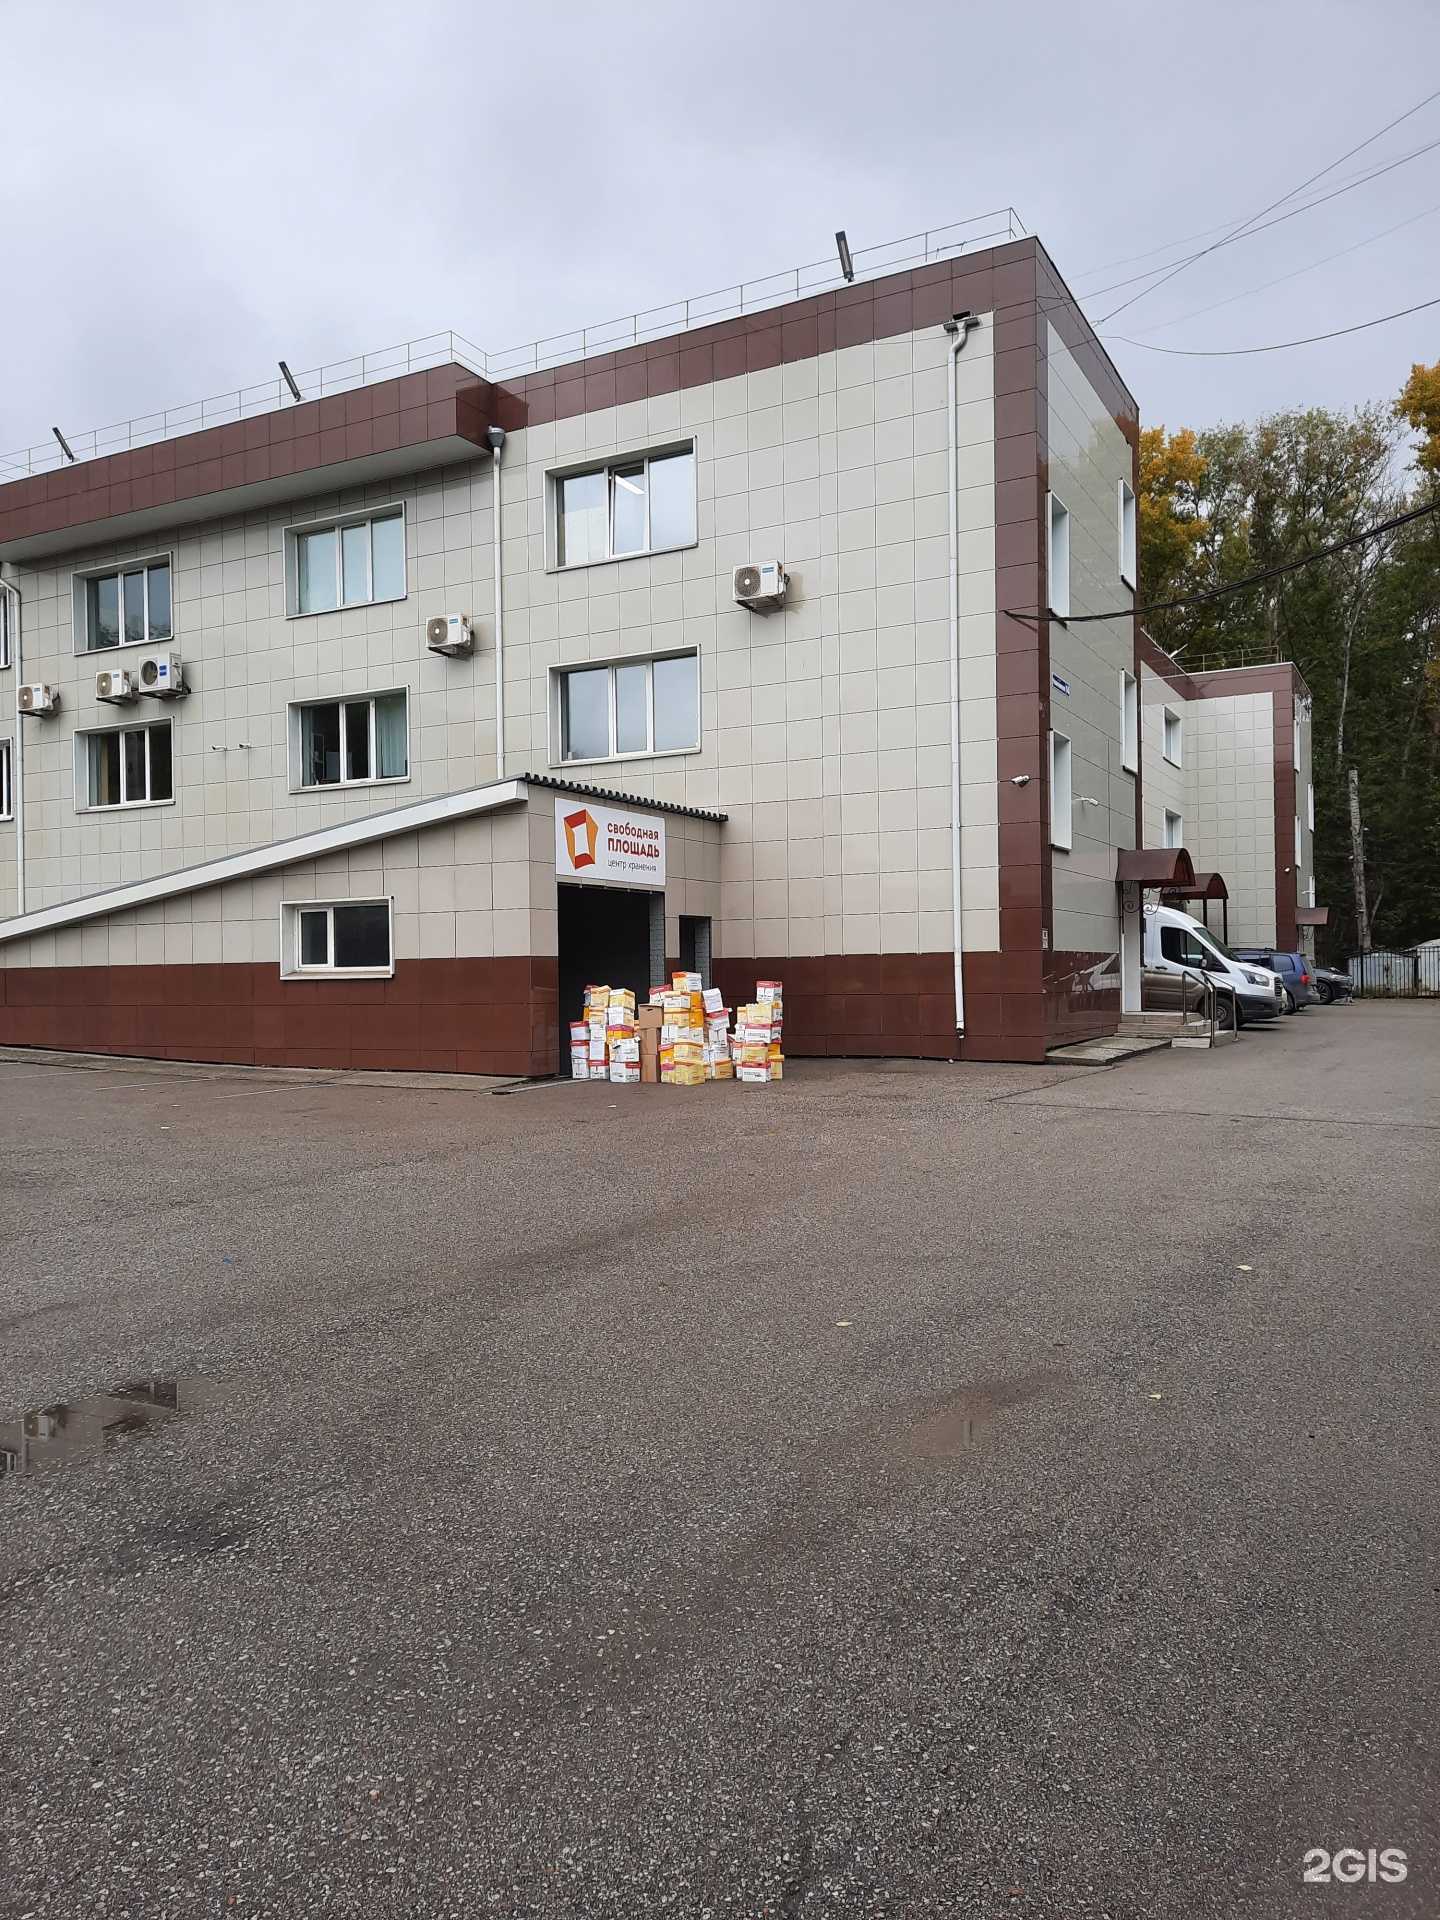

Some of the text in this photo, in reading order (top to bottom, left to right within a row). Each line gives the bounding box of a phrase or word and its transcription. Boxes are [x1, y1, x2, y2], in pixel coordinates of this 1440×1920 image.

[607, 821, 659, 841] свободная
[607, 837, 660, 859] ПЛОЩАДЬ
[607, 859, 627, 871] центр
